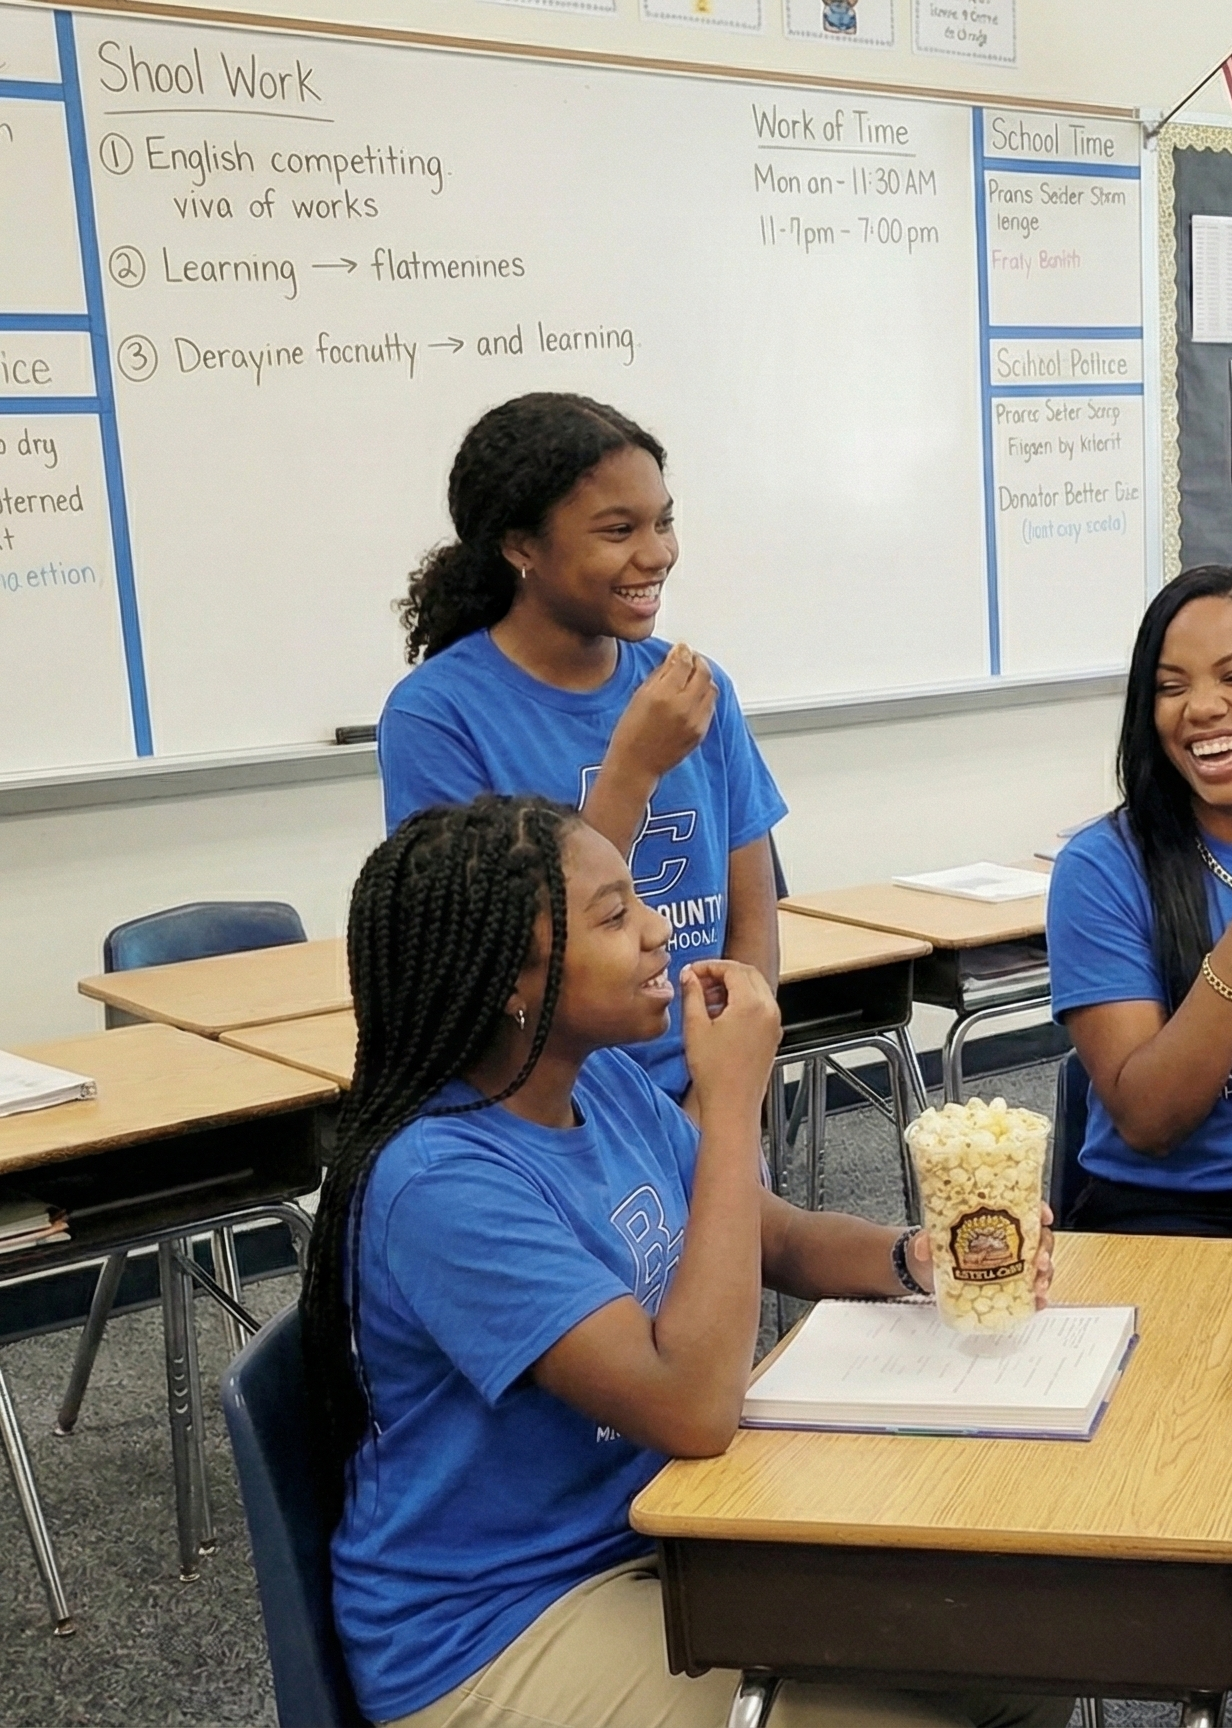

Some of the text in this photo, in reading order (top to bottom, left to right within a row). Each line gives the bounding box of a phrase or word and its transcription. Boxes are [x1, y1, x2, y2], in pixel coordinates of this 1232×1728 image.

[98, 40, 322, 102] Shool Work
[752, 104, 908, 145] Work of Time
[992, 115, 1114, 158] School Time
[145, 136, 254, 187] English
[905, 169, 936, 195] AM
[173, 187, 378, 219] viva of works
[163, 246, 297, 301] Learning
[477, 324, 523, 356] and
[18, 428, 58, 469] dry
[1058, 437, 1075, 461] by
